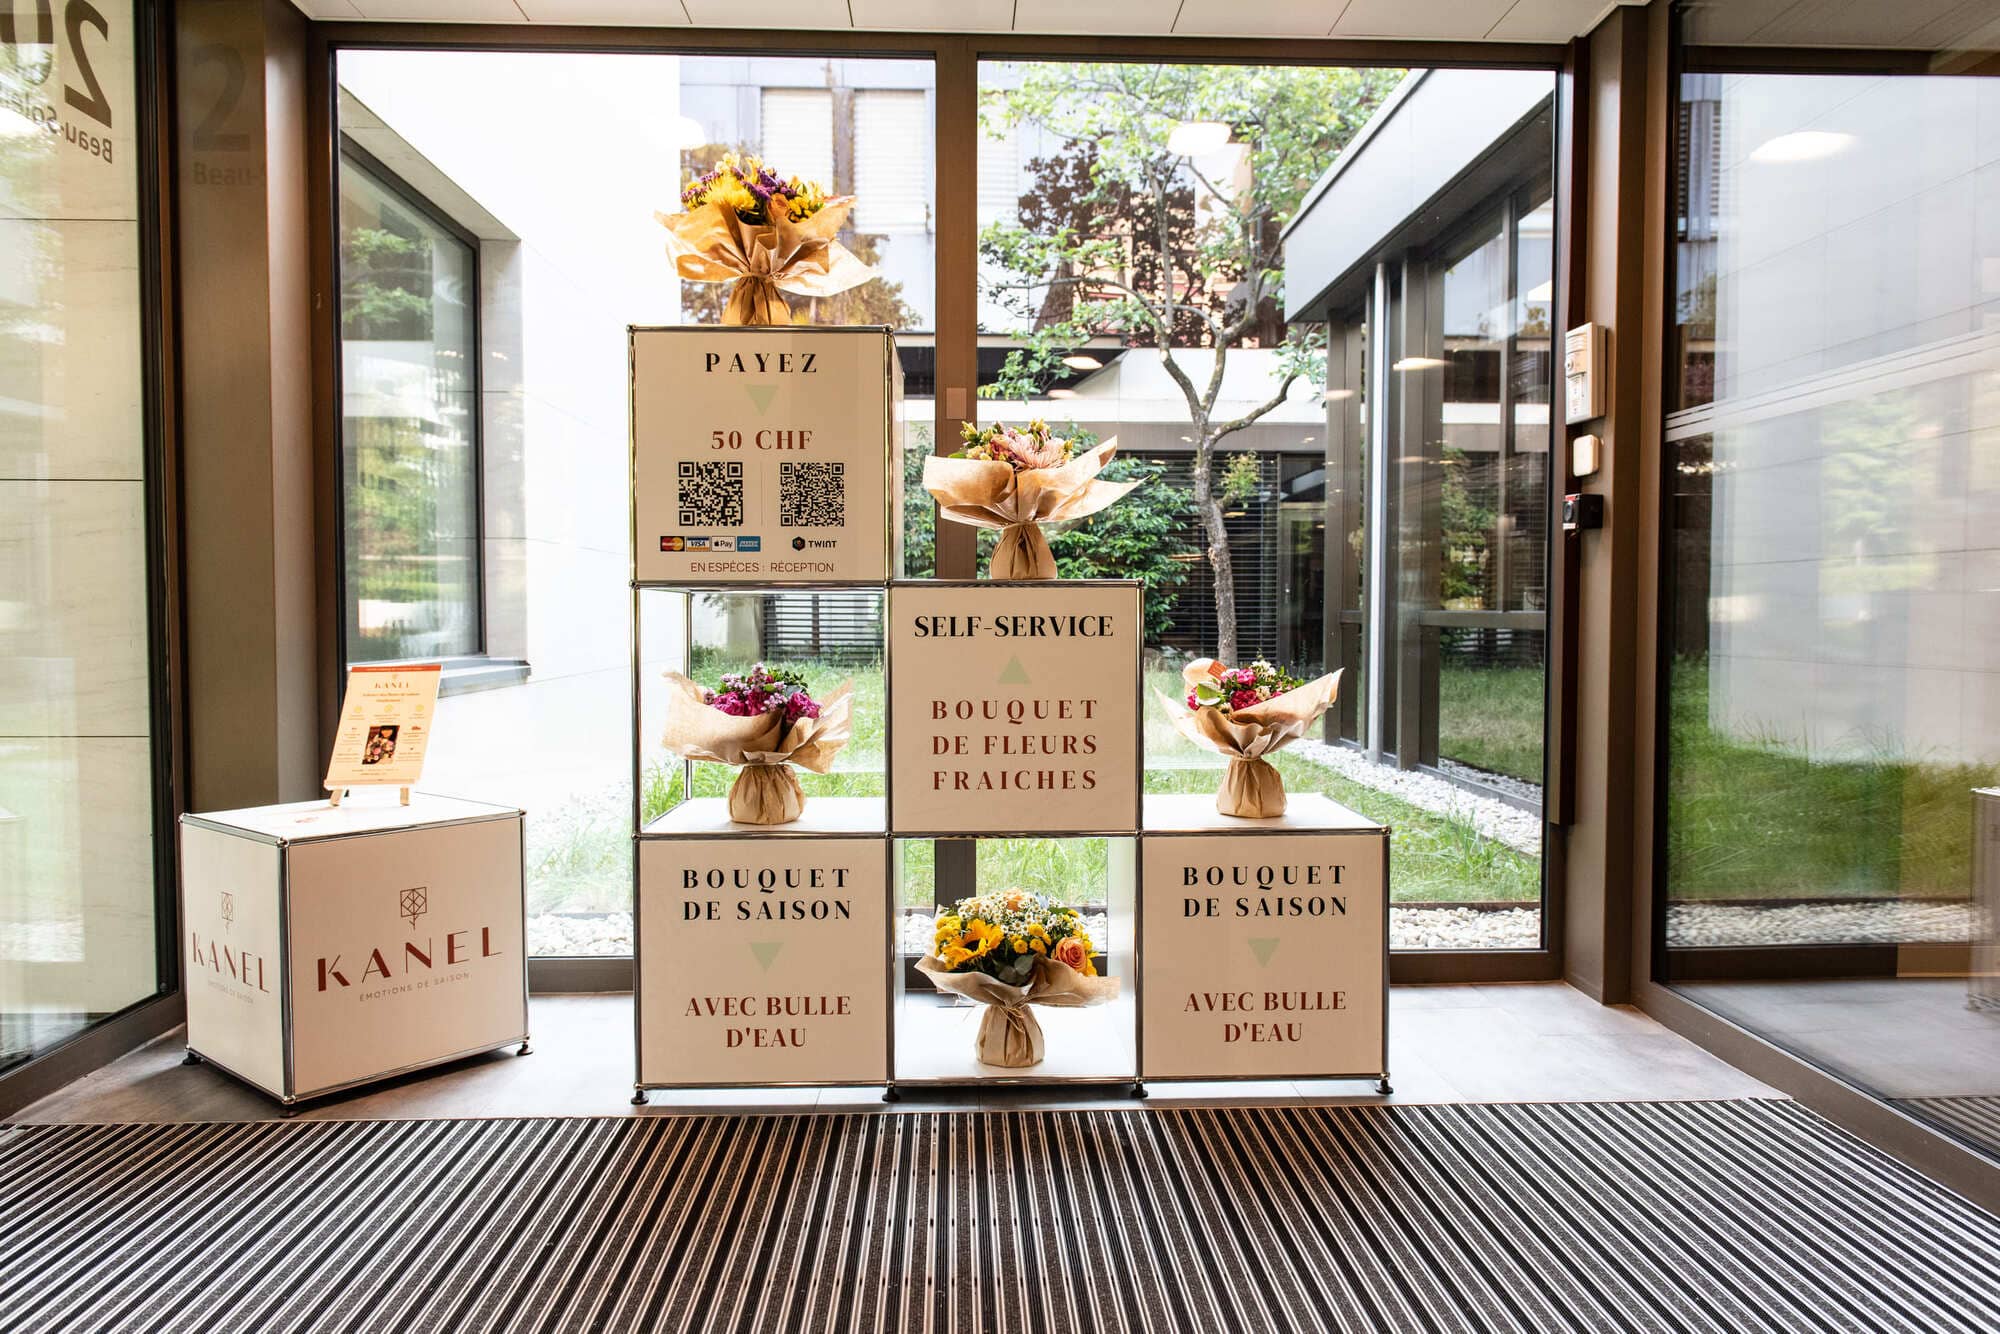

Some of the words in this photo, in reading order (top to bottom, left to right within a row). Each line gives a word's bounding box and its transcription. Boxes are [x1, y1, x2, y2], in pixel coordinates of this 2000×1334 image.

[705, 352, 818, 373] PAYEZ
[711, 430, 743, 450] 50
[755, 429, 814, 450] CHF
[690, 562, 706, 573] EN
[770, 560, 834, 573] RÉCEPTION
[914, 615, 1114, 638] SELF-SERVICE
[931, 699, 1097, 725] BOUQUET
[932, 735, 969, 755] DE
[984, 735, 1097, 755] FLEURS
[933, 769, 1097, 791] FRAICHES
[682, 868, 850, 894] BOUQUET
[1183, 865, 1346, 890] BOUQUET
[683, 900, 721, 921] DE
[736, 899, 851, 921] SAISON
[1183, 897, 1220, 918] DE
[1235, 896, 1347, 917] SAISON
[192, 931, 271, 994] KANEL
[317, 926, 504, 993] KANEL
[685, 996, 756, 1017] AVEC
[766, 995, 851, 1016] BULLE
[1184, 992, 1254, 1012] AVEC
[1263, 991, 1347, 1011] BULLE
[726, 1027, 806, 1048] D'EAU
[1223, 1022, 1303, 1043] D'EAU
